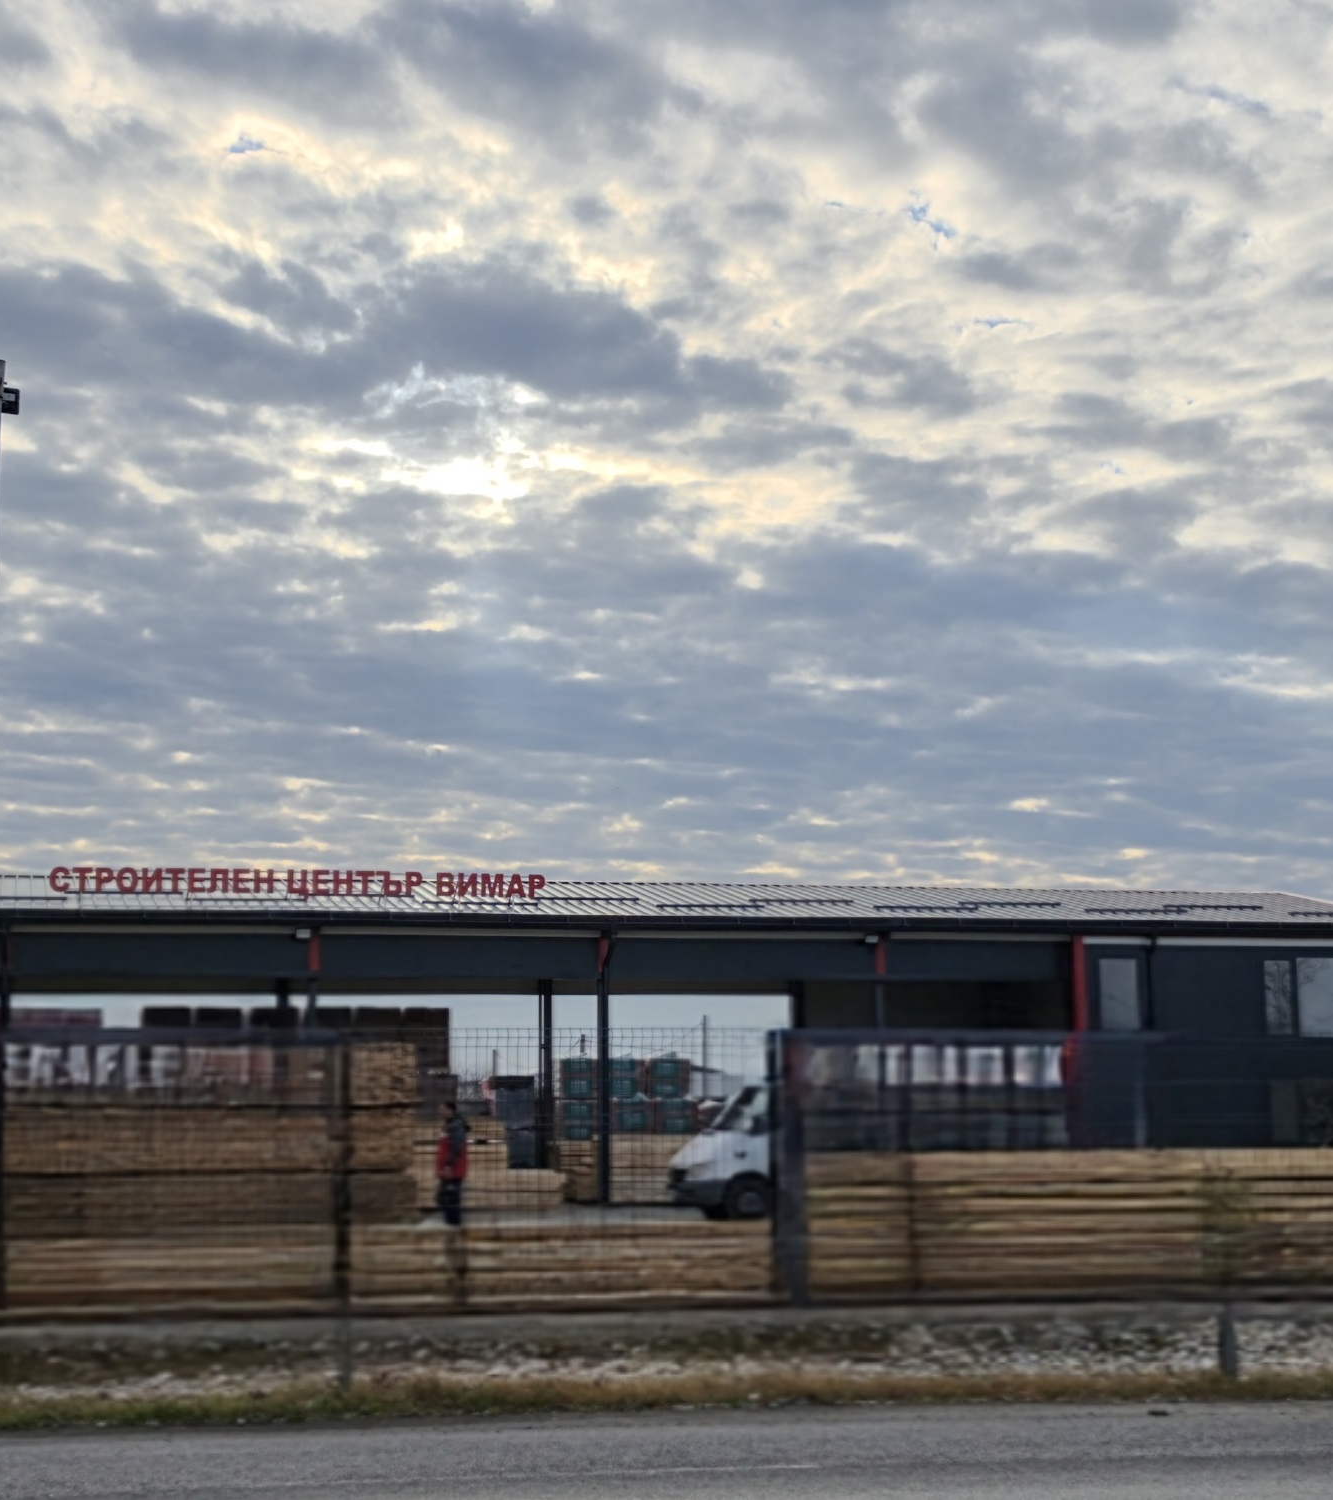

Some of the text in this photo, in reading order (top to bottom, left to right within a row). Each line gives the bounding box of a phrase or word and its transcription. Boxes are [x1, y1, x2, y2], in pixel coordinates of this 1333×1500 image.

[49, 866, 546, 899] СТРОИТЕЛЕН ЦЕНТЪР ВИМАР
